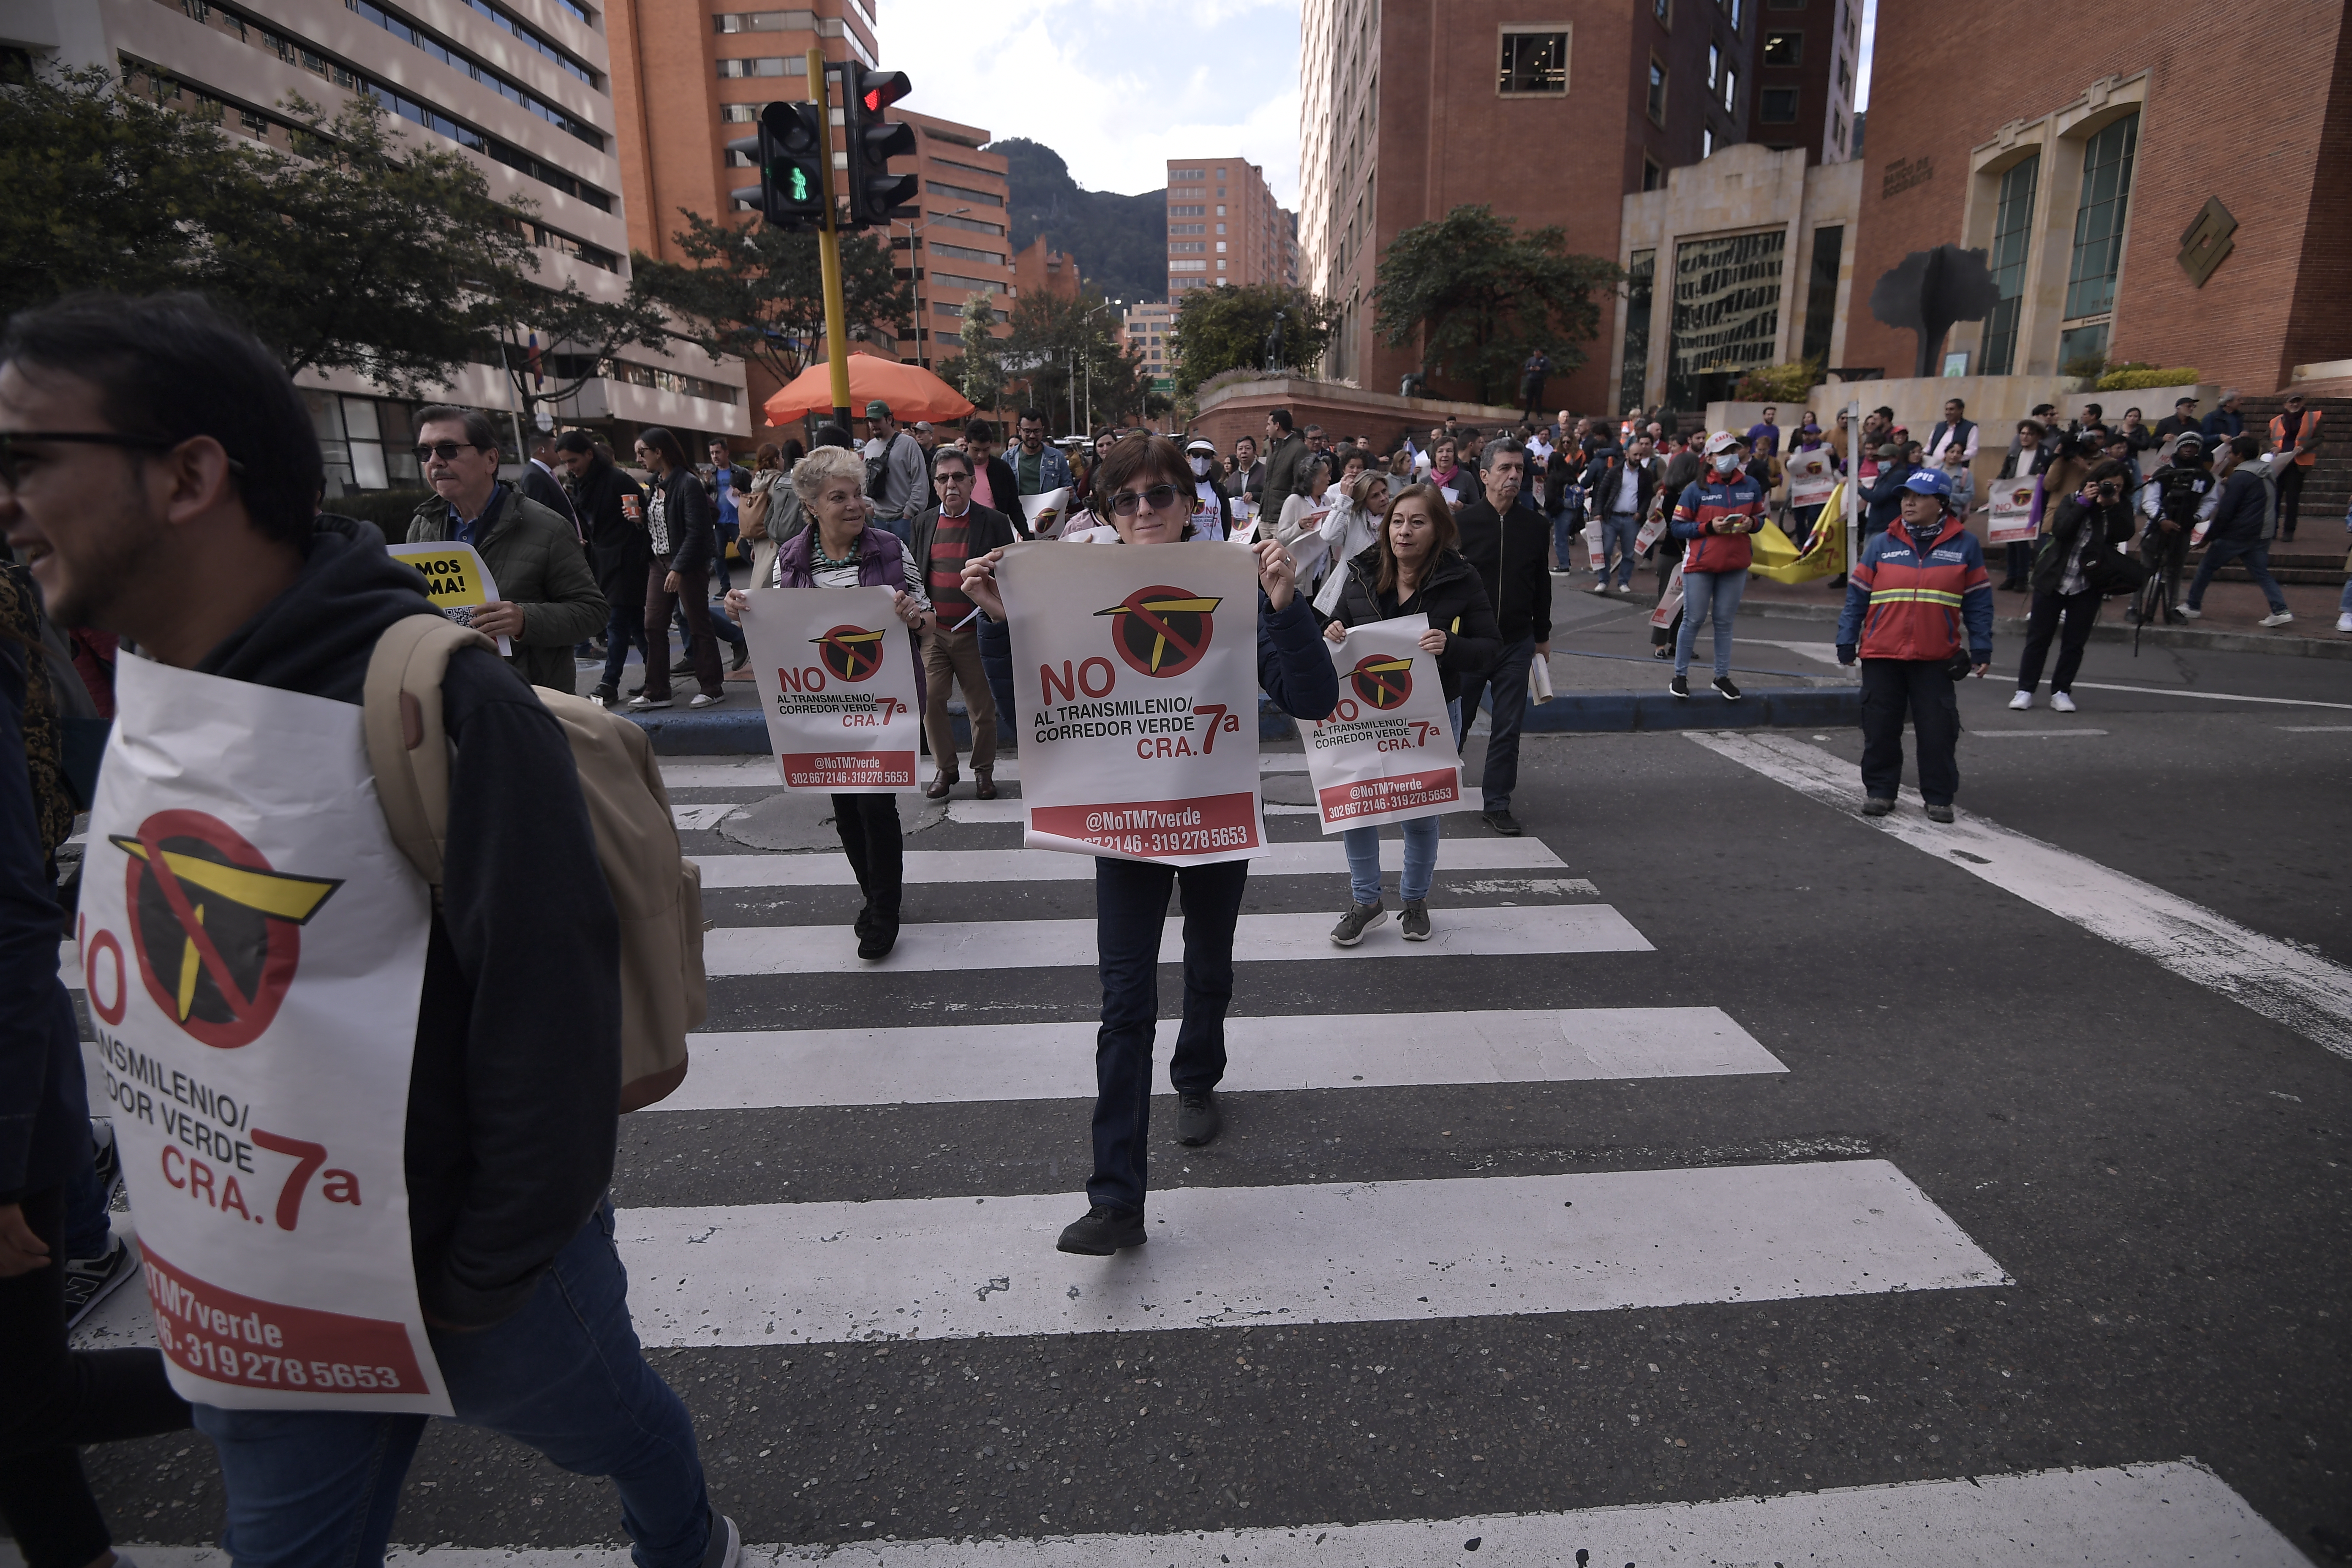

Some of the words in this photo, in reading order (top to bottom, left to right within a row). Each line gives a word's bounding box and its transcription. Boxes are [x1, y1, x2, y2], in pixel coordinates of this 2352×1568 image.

[1206, 506, 1218, 514] NO
[1881, 550, 1910, 559] GAEPVD
[778, 667, 826, 693] NO
[1040, 656, 1116, 706] NO
[777, 694, 790, 704] AL
[791, 693, 874, 704] TRANSMILENIO/
[779, 704, 840, 715] CORREDOR
[842, 703, 879, 712] VERDE
[1034, 711, 1054, 727] AL
[1056, 696, 1193, 723] TRANSMILENIO/
[842, 715, 880, 727] CRA.
[875, 697, 907, 726] 7a
[1035, 721, 1132, 743] CORREDOR
[1137, 716, 1195, 735] VERDE
[1137, 736, 1198, 760] CRA.
[1193, 704, 1239, 754] 7a
[1313, 728, 1325, 738] AL
[1327, 718, 1407, 736] TRANSMILENIO/
[1315, 732, 1373, 749] CORREDOR
[1375, 727, 1411, 739] VERDE
[1377, 739, 1415, 752] CRA.
[1407, 721, 1440, 747] 7a
[815, 756, 880, 769] @NoTM7verde
[1350, 778, 1422, 799] @NoTM7verde
[1086, 806, 1200, 832] @NoTM7verde
[79, 912, 127, 1025] O
[104, 1068, 154, 1125] DOR
[161, 1102, 254, 1174] VERDE
[161, 1144, 264, 1224] CRA.
[250, 1127, 362, 1231] 7a
[145, 1261, 283, 1348] TM7verde
